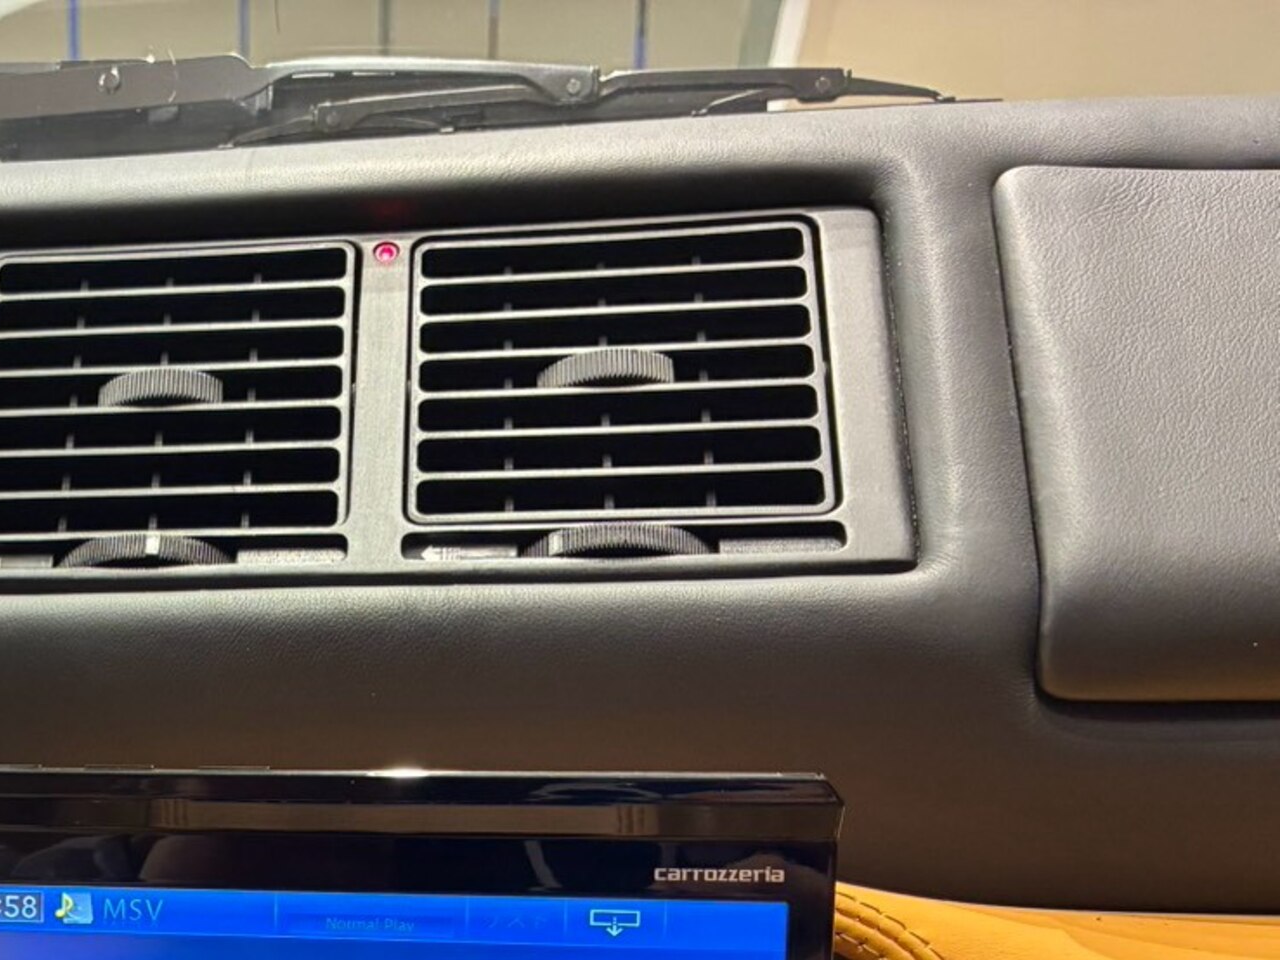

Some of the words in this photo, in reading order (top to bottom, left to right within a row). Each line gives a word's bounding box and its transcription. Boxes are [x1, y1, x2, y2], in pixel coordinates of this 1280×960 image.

[654, 867, 786, 884] carrozzeria
[102, 897, 164, 921] MSV
[325, 917, 380, 931] Normal
[384, 918, 415, 933] Play
